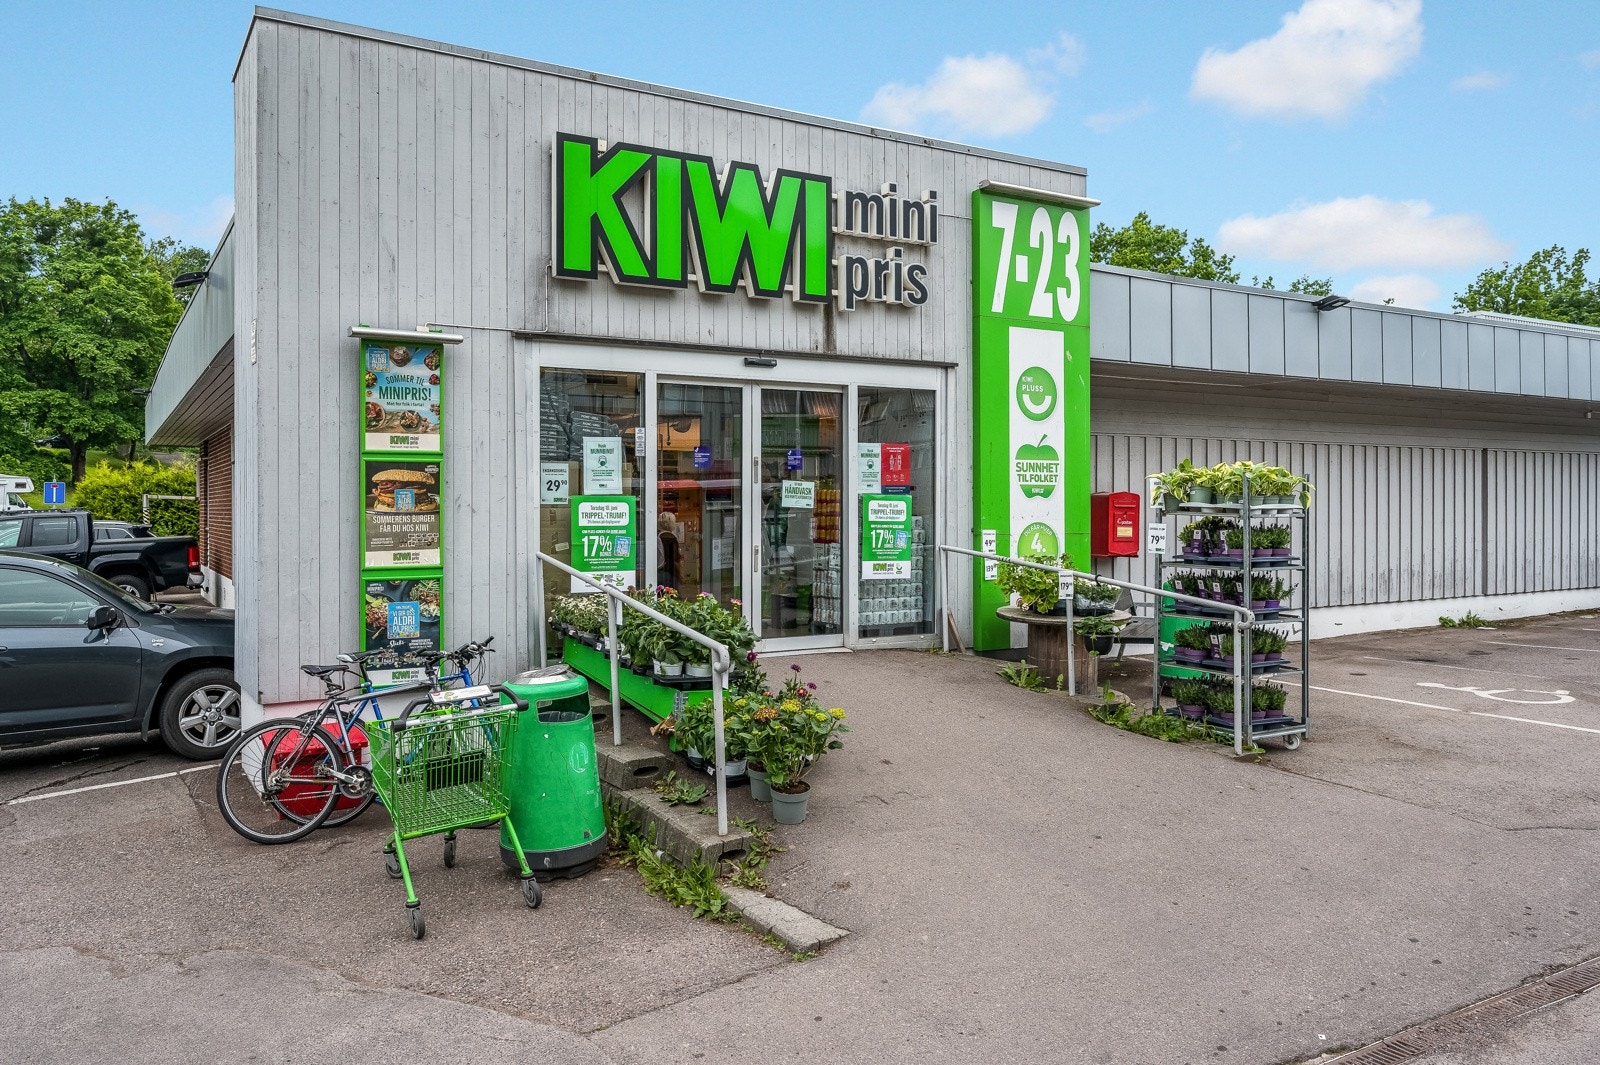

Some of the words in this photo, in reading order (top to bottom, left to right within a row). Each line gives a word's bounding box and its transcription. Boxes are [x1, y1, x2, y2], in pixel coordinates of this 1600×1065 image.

[553, 131, 832, 304] KIWI
[838, 181, 938, 246] mini
[991, 200, 1081, 322] 7-23
[838, 246, 929, 312] pris
[385, 374, 414, 384] SOMMER
[416, 376, 425, 386] TIL
[378, 386, 432, 400] MINIPRIS!
[390, 436, 409, 445] KIWI
[1016, 462, 1059, 473] SUNNHET
[1017, 474, 1028, 482] TIL
[1030, 474, 1058, 482] FOLKET
[546, 480, 560, 492] 29
[785, 484, 812, 495] HÅNDVASK
[372, 515, 410, 524] SOMMERENS
[380, 524, 391, 533] FÅR
[870, 530, 894, 548] 17%
[1031, 533, 1046, 552] 4.
[1151, 535, 1160, 544] 79
[582, 536, 612, 557] 17%
[393, 552, 411, 561] KIWI
[873, 563, 887, 572] KIWI
[393, 616, 415, 626] ALDRI
[392, 671, 410, 679] KIWI
